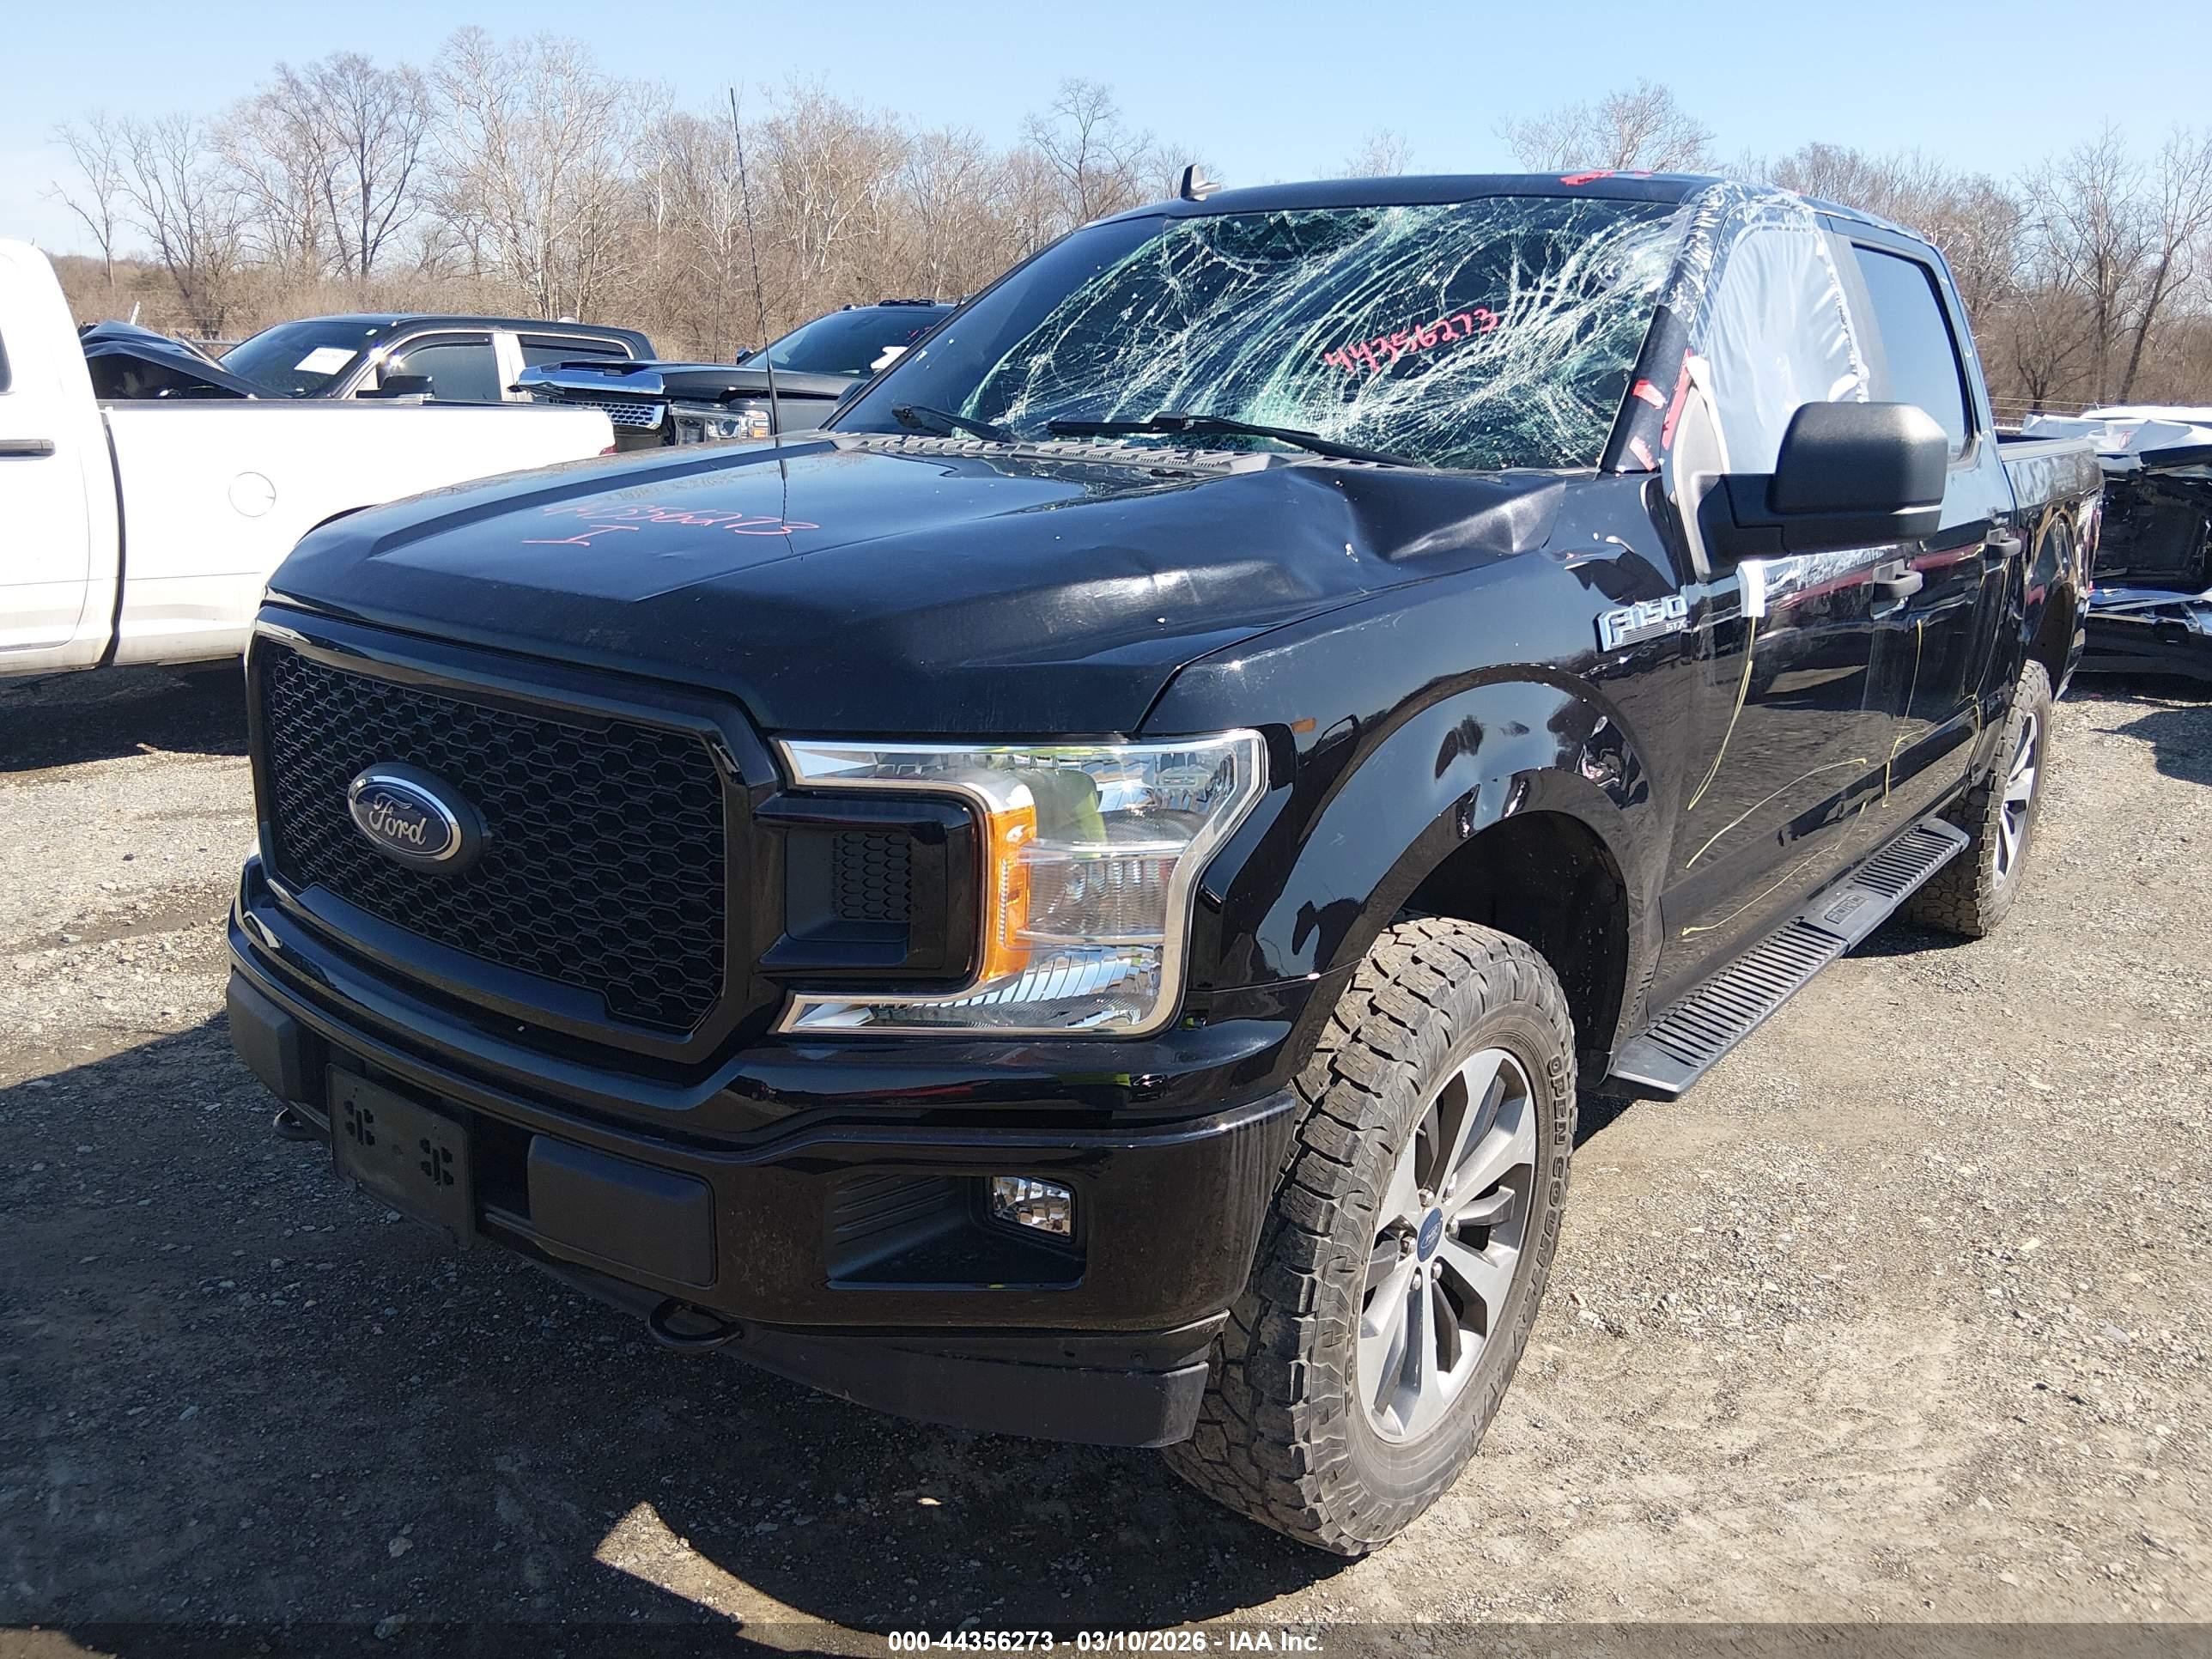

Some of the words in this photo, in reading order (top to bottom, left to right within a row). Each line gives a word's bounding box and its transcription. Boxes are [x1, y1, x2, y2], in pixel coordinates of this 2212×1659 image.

[1323, 308, 1498, 373] 44356273
[1665, 618, 1689, 632] STX
[369, 792, 428, 846] Ford
[1546, 1055, 1568, 1146] OPEN
